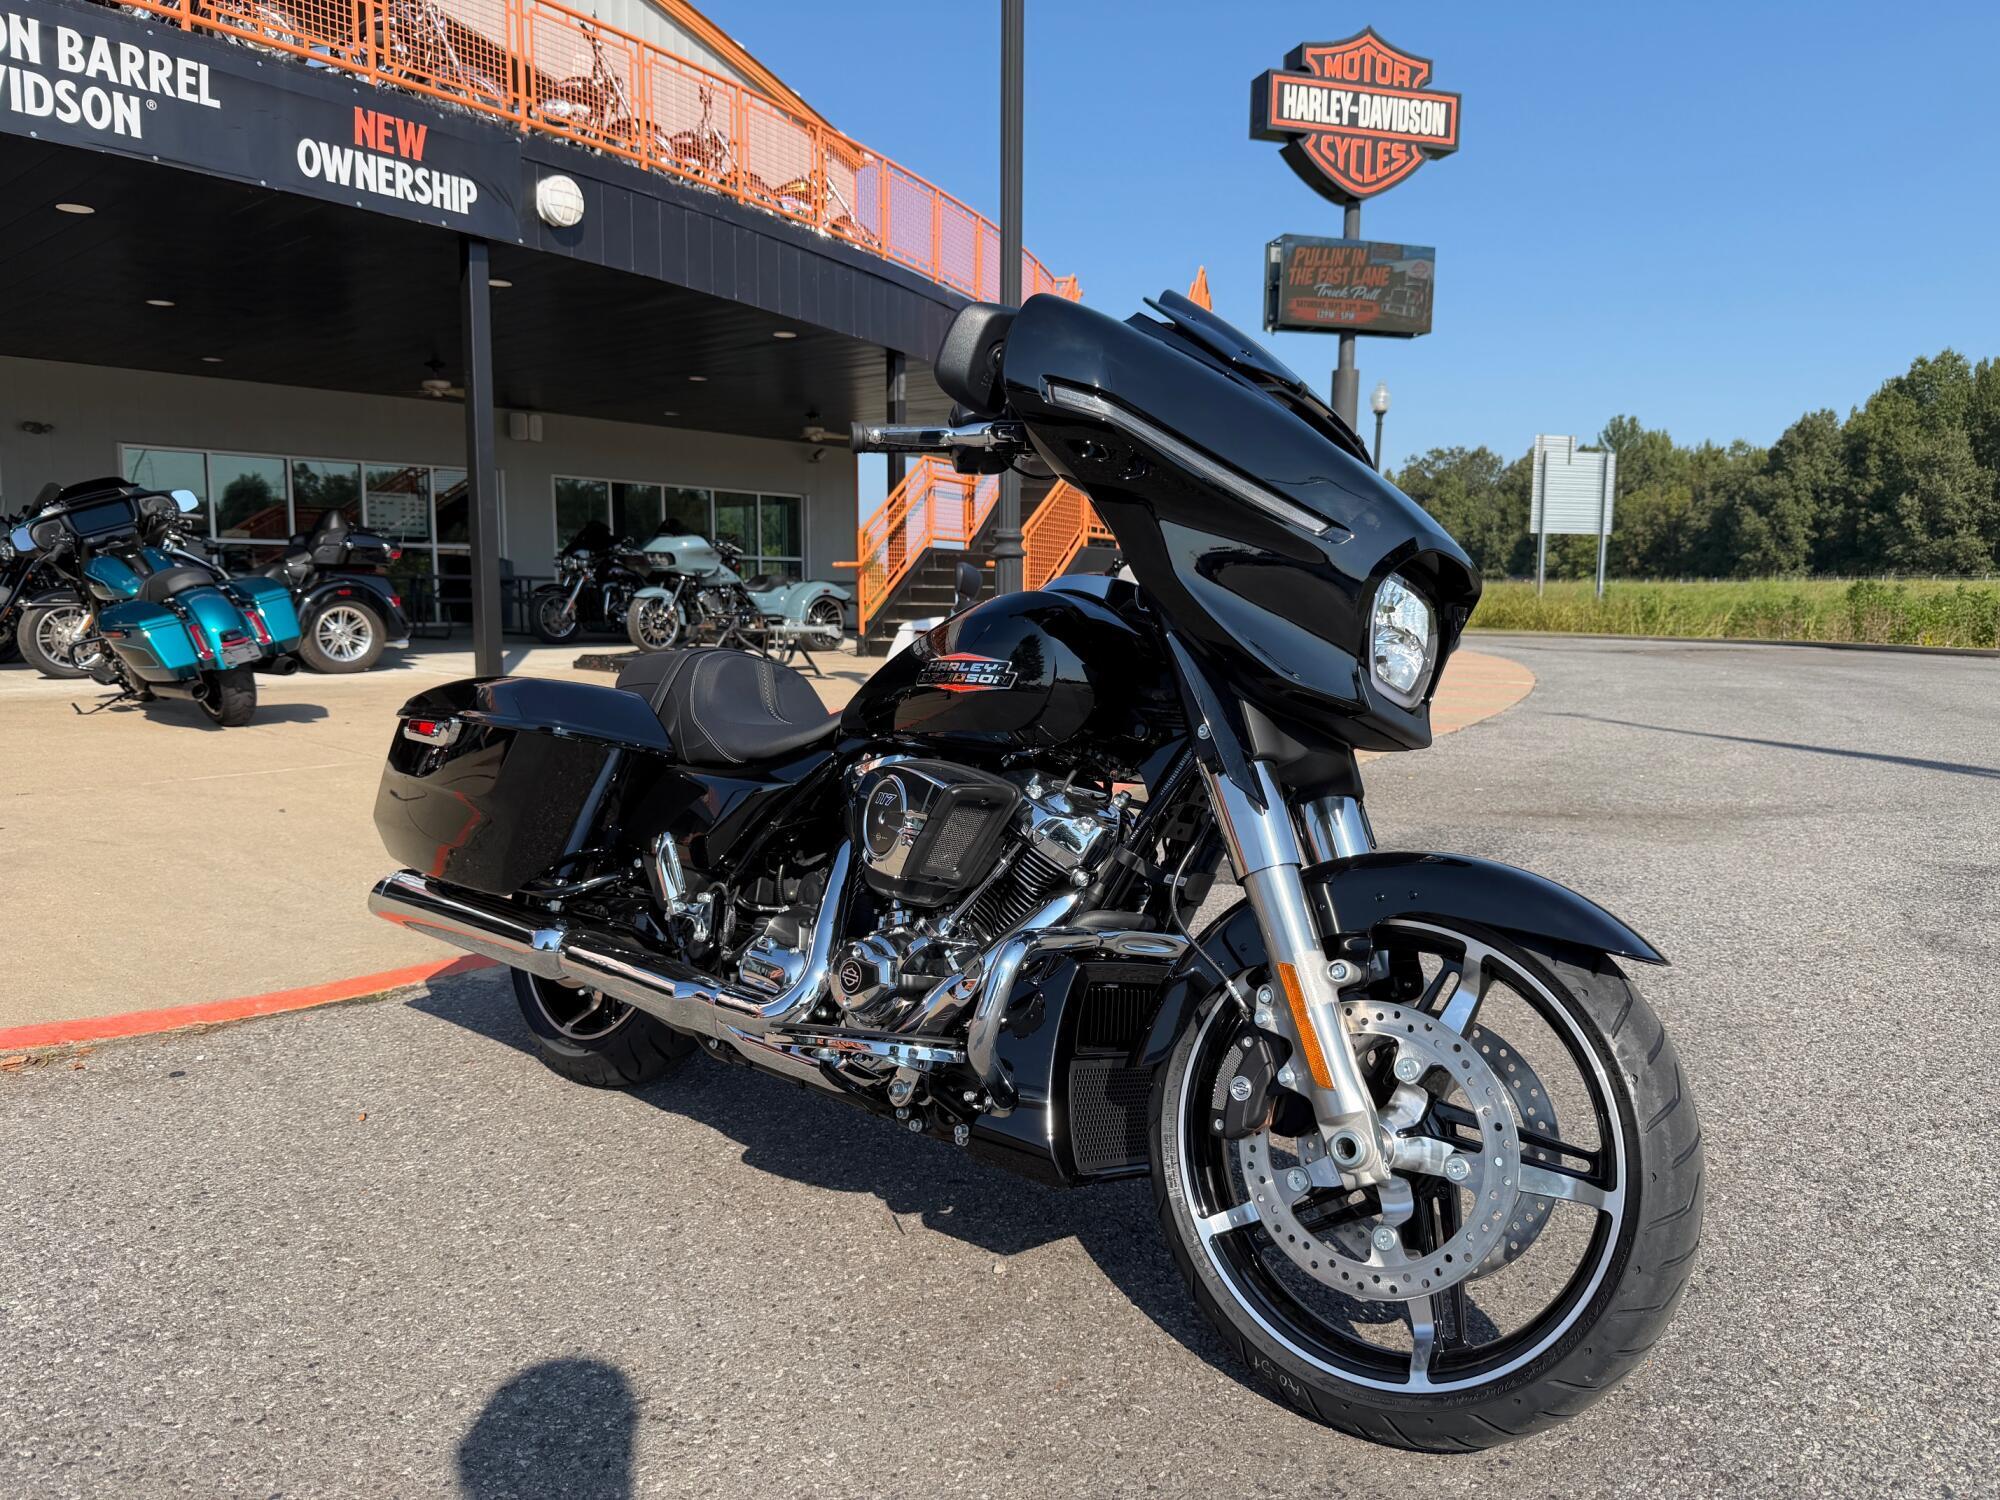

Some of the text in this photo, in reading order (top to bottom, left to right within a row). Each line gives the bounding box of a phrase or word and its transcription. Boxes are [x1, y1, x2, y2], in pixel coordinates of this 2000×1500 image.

[56, 26, 221, 109] BARREL
[1324, 45, 1411, 88] MOTOR
[1282, 84, 1446, 136] HARLEY-DAVIDSON
[354, 106, 428, 161] NEW
[297, 138, 478, 215] OWNERSHIP
[1320, 134, 1409, 183] CYCLES
[1289, 267, 1391, 287] THE FAST LANE
[1294, 247, 1351, 266] PULLIN'
[1352, 248, 1367, 266] IN
[1313, 283, 1382, 301] Truck Pull
[875, 791, 898, 806] 117
